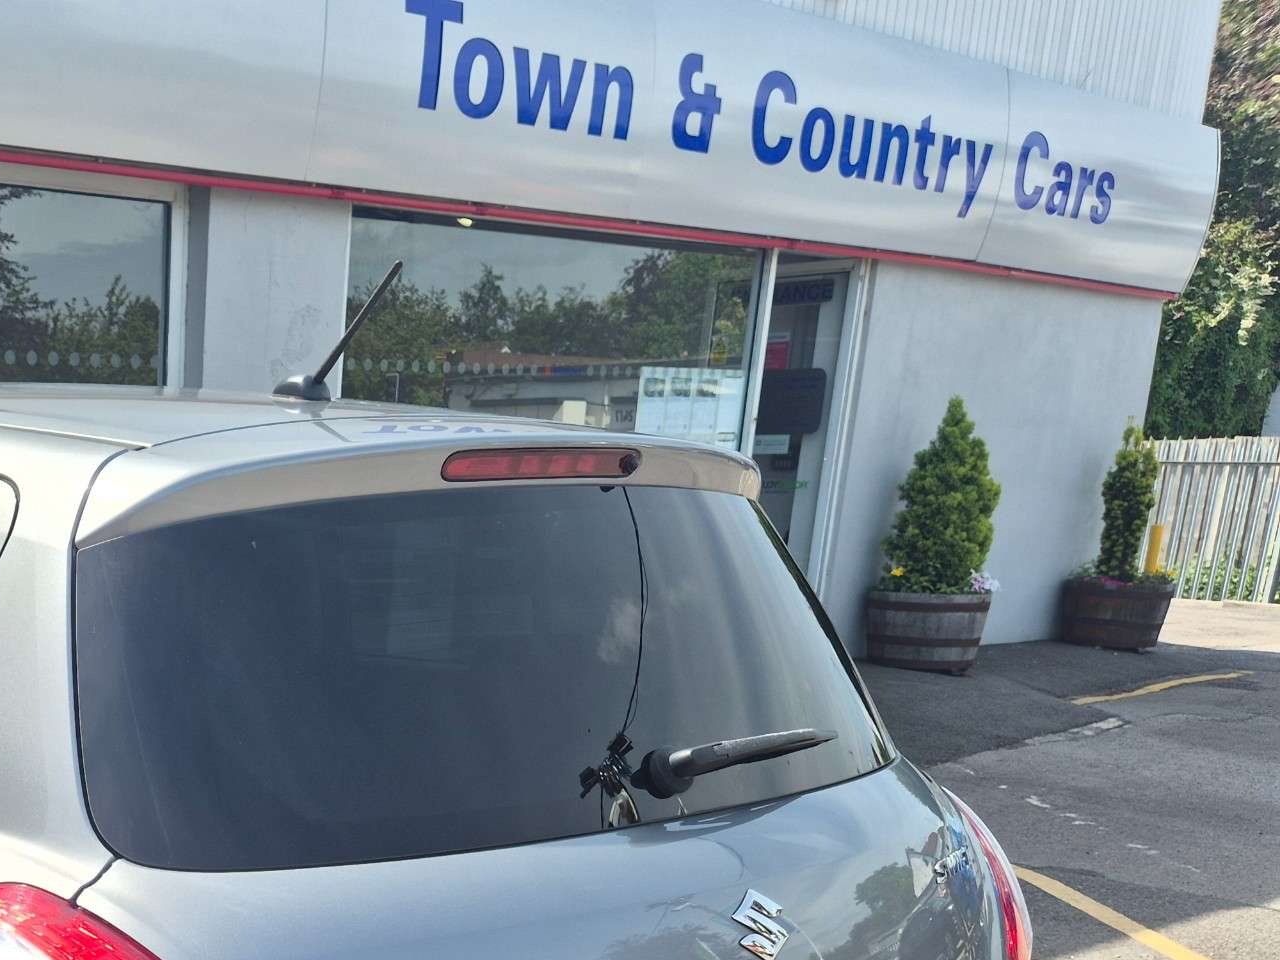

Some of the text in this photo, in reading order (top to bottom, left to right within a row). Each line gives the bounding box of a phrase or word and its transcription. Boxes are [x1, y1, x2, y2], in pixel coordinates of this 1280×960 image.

[404, 0, 1117, 225] Town & Country Cars
